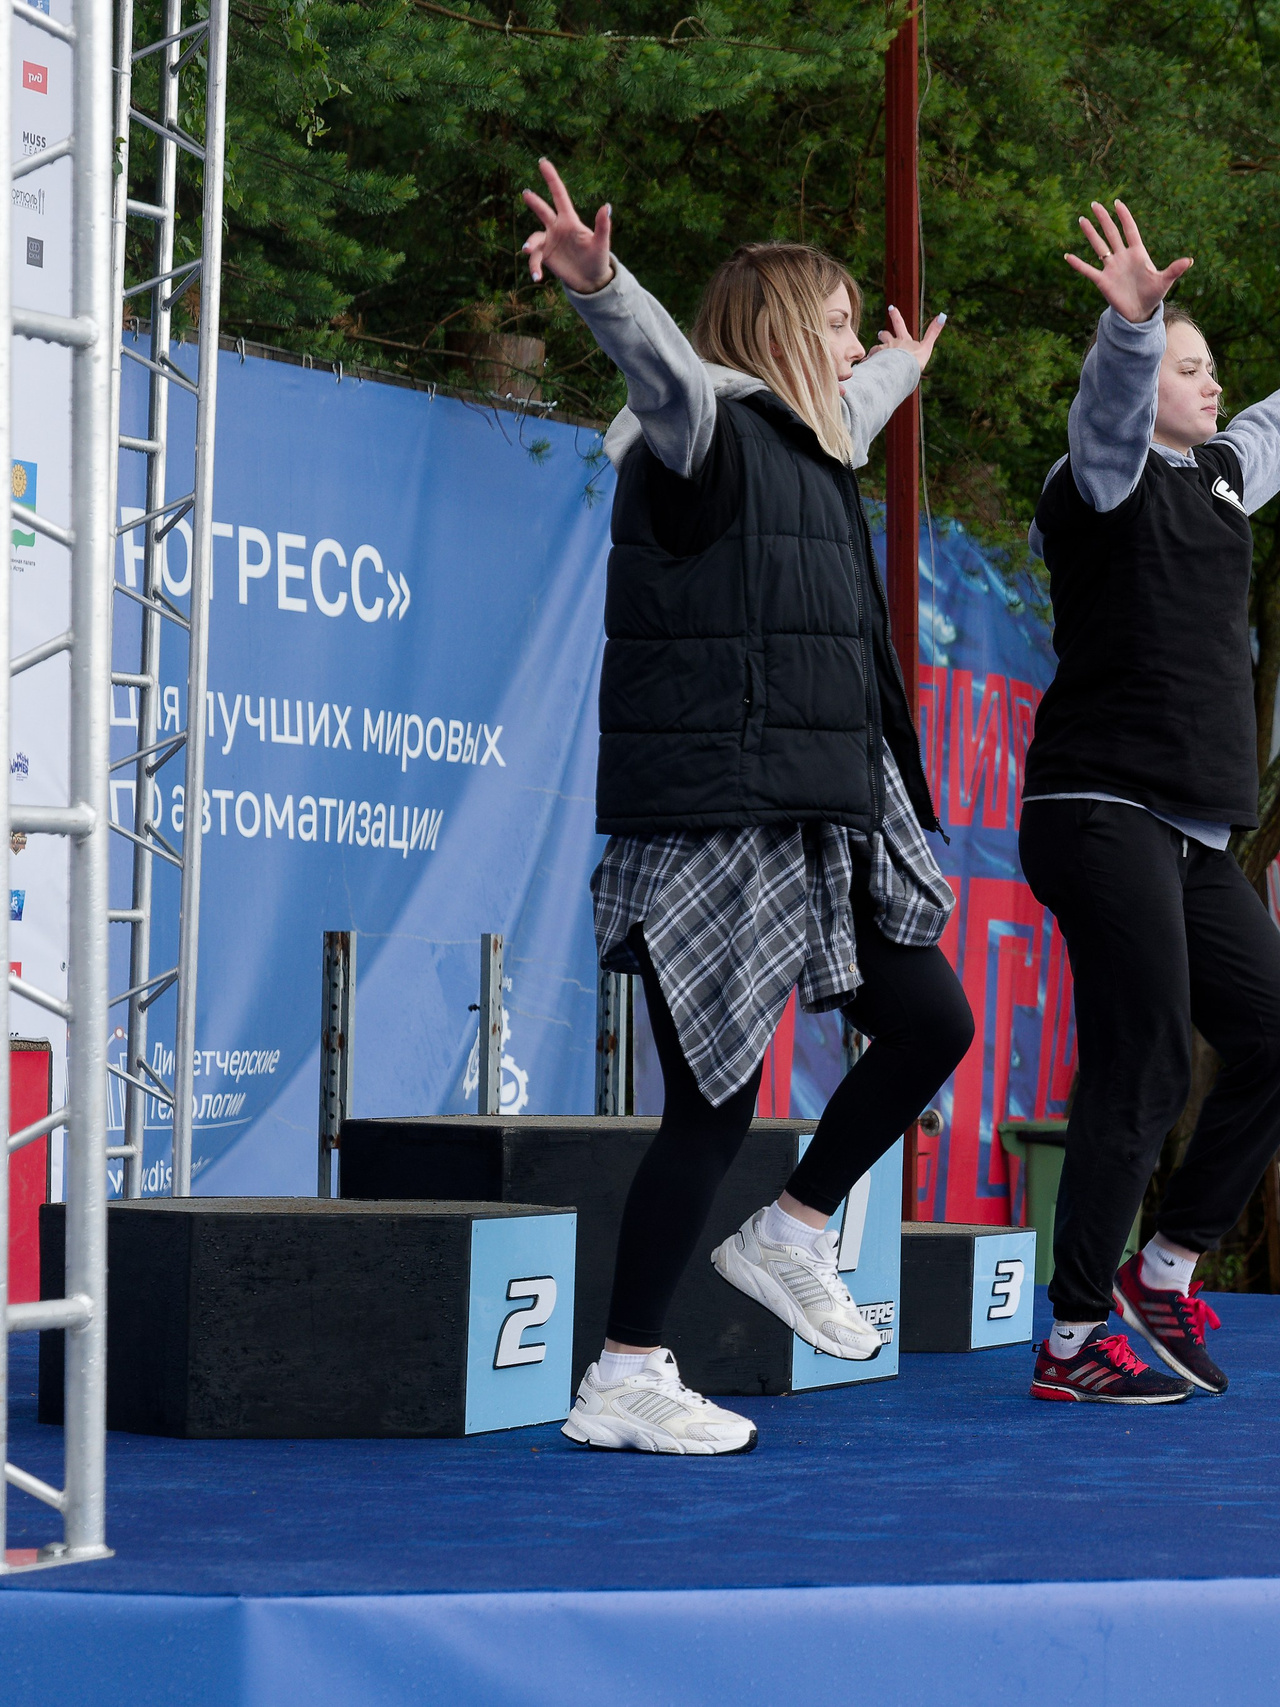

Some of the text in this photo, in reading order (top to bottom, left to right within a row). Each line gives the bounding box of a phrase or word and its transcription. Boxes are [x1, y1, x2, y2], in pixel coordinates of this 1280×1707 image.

[22, 131, 47, 149] MUSS
[362, 707, 507, 773] мировых
[987, 1259, 1025, 1321] 3
[493, 1275, 558, 1370] 2
